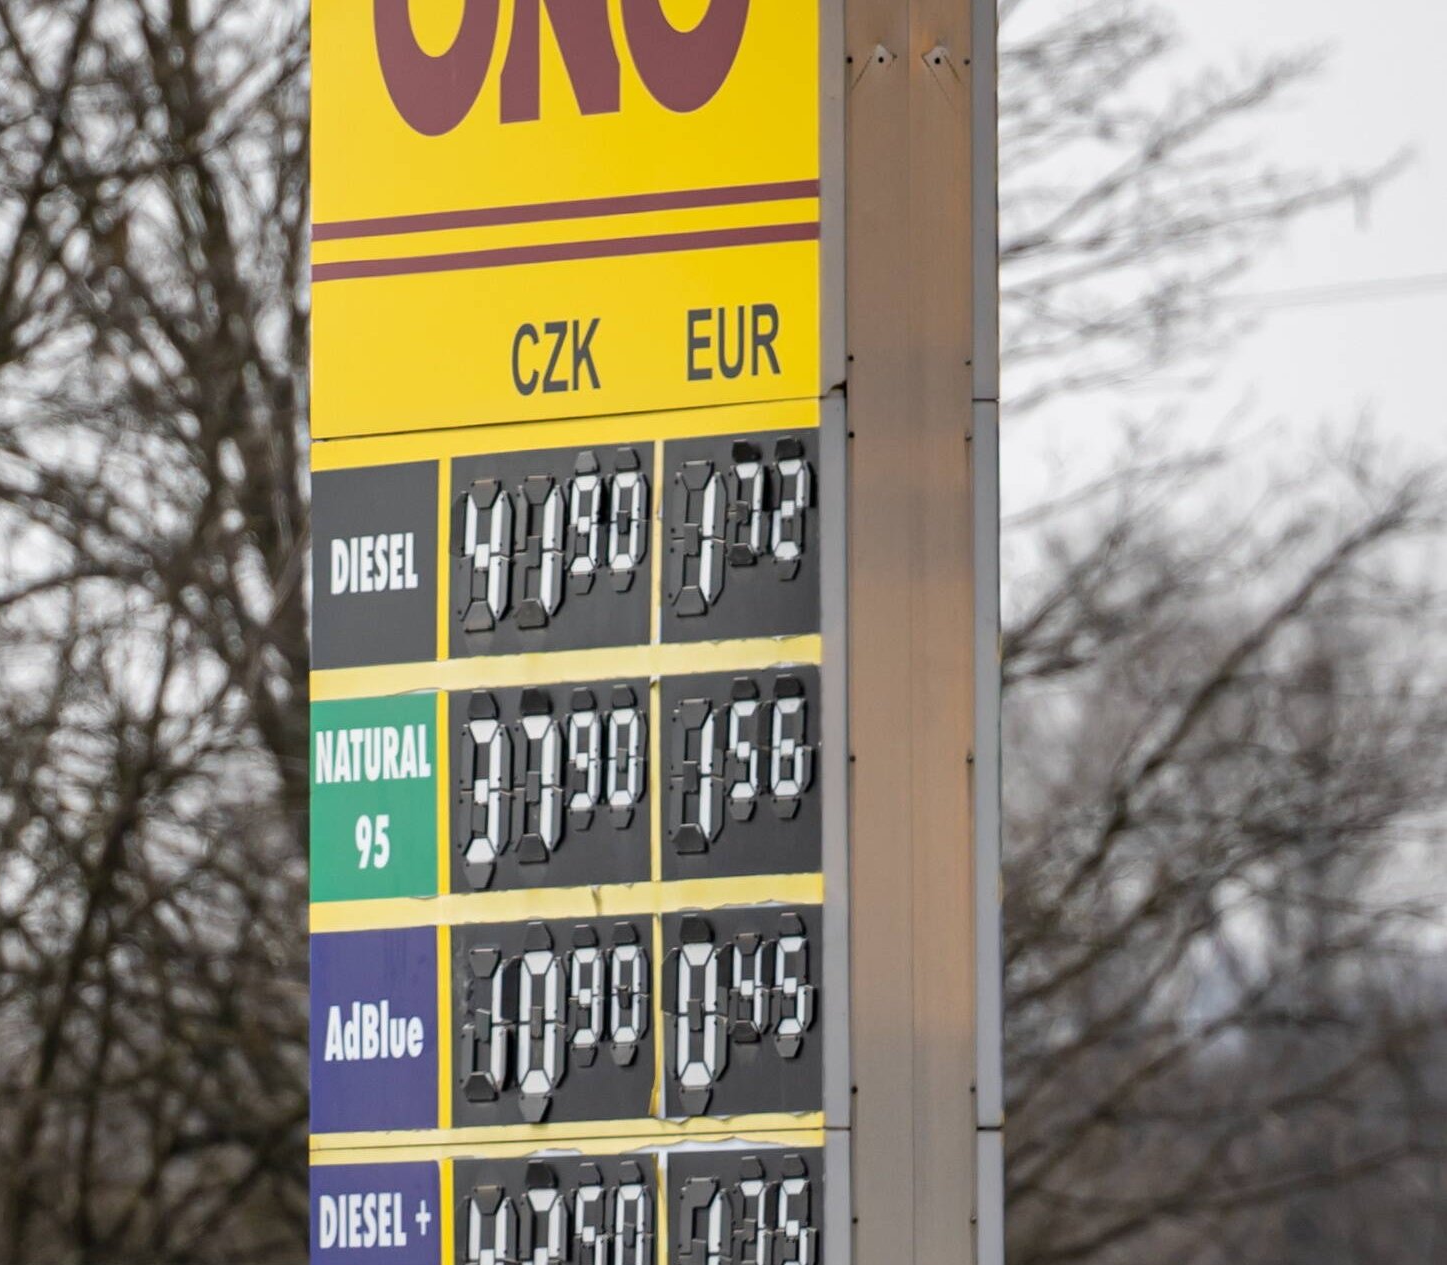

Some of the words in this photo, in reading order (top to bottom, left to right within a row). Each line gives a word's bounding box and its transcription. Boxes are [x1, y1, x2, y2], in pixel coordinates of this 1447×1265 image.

[511, 317, 602, 397] CZK
[686, 302, 782, 382] EUR
[329, 531, 420, 596] DIESEL
[315, 723, 432, 785] NATURAL
[354, 814, 391, 870] 95
[323, 998, 425, 1063] AdBlue
[318, 1191, 408, 1250] DIESEL
